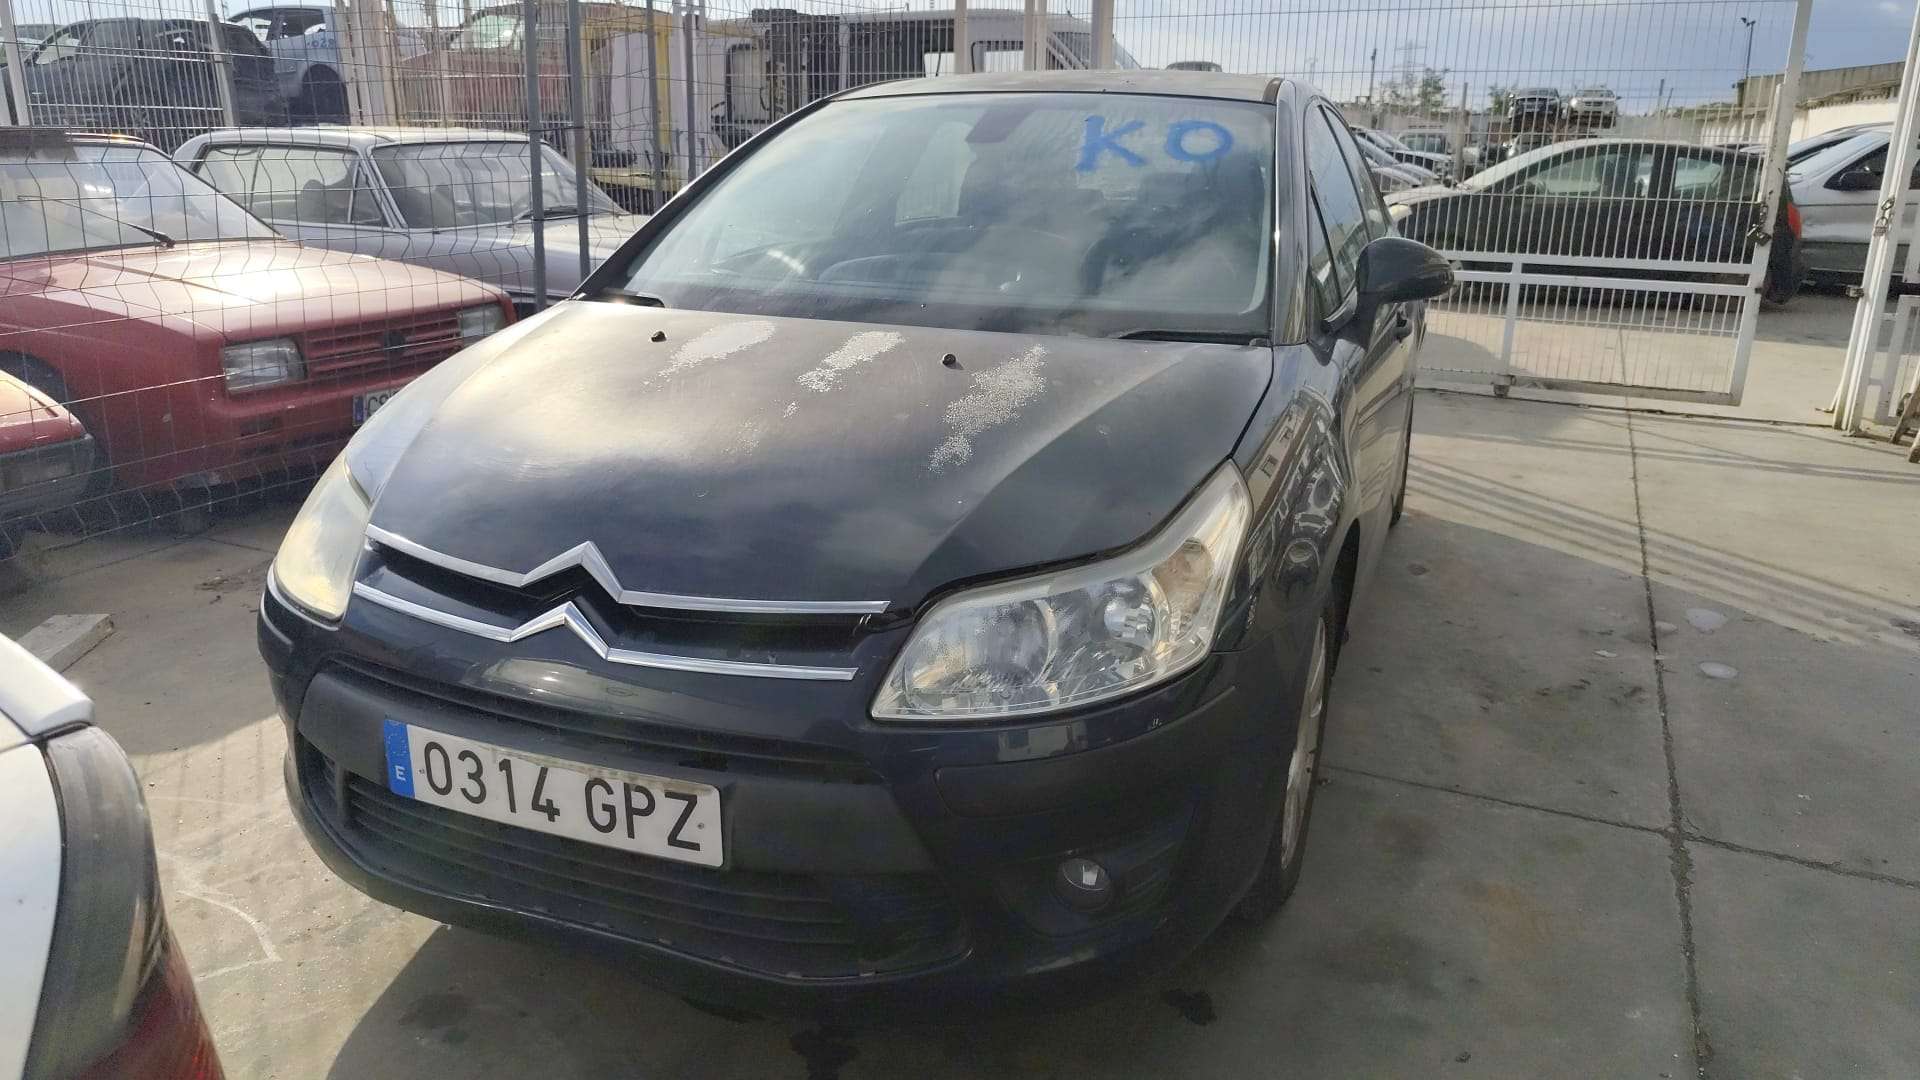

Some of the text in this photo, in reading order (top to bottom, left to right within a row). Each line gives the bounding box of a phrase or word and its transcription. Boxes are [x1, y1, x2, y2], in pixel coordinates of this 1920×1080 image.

[1076, 115, 1233, 172] KO
[395, 765, 406, 781] E
[424, 741, 701, 852] 0314 GPZ
